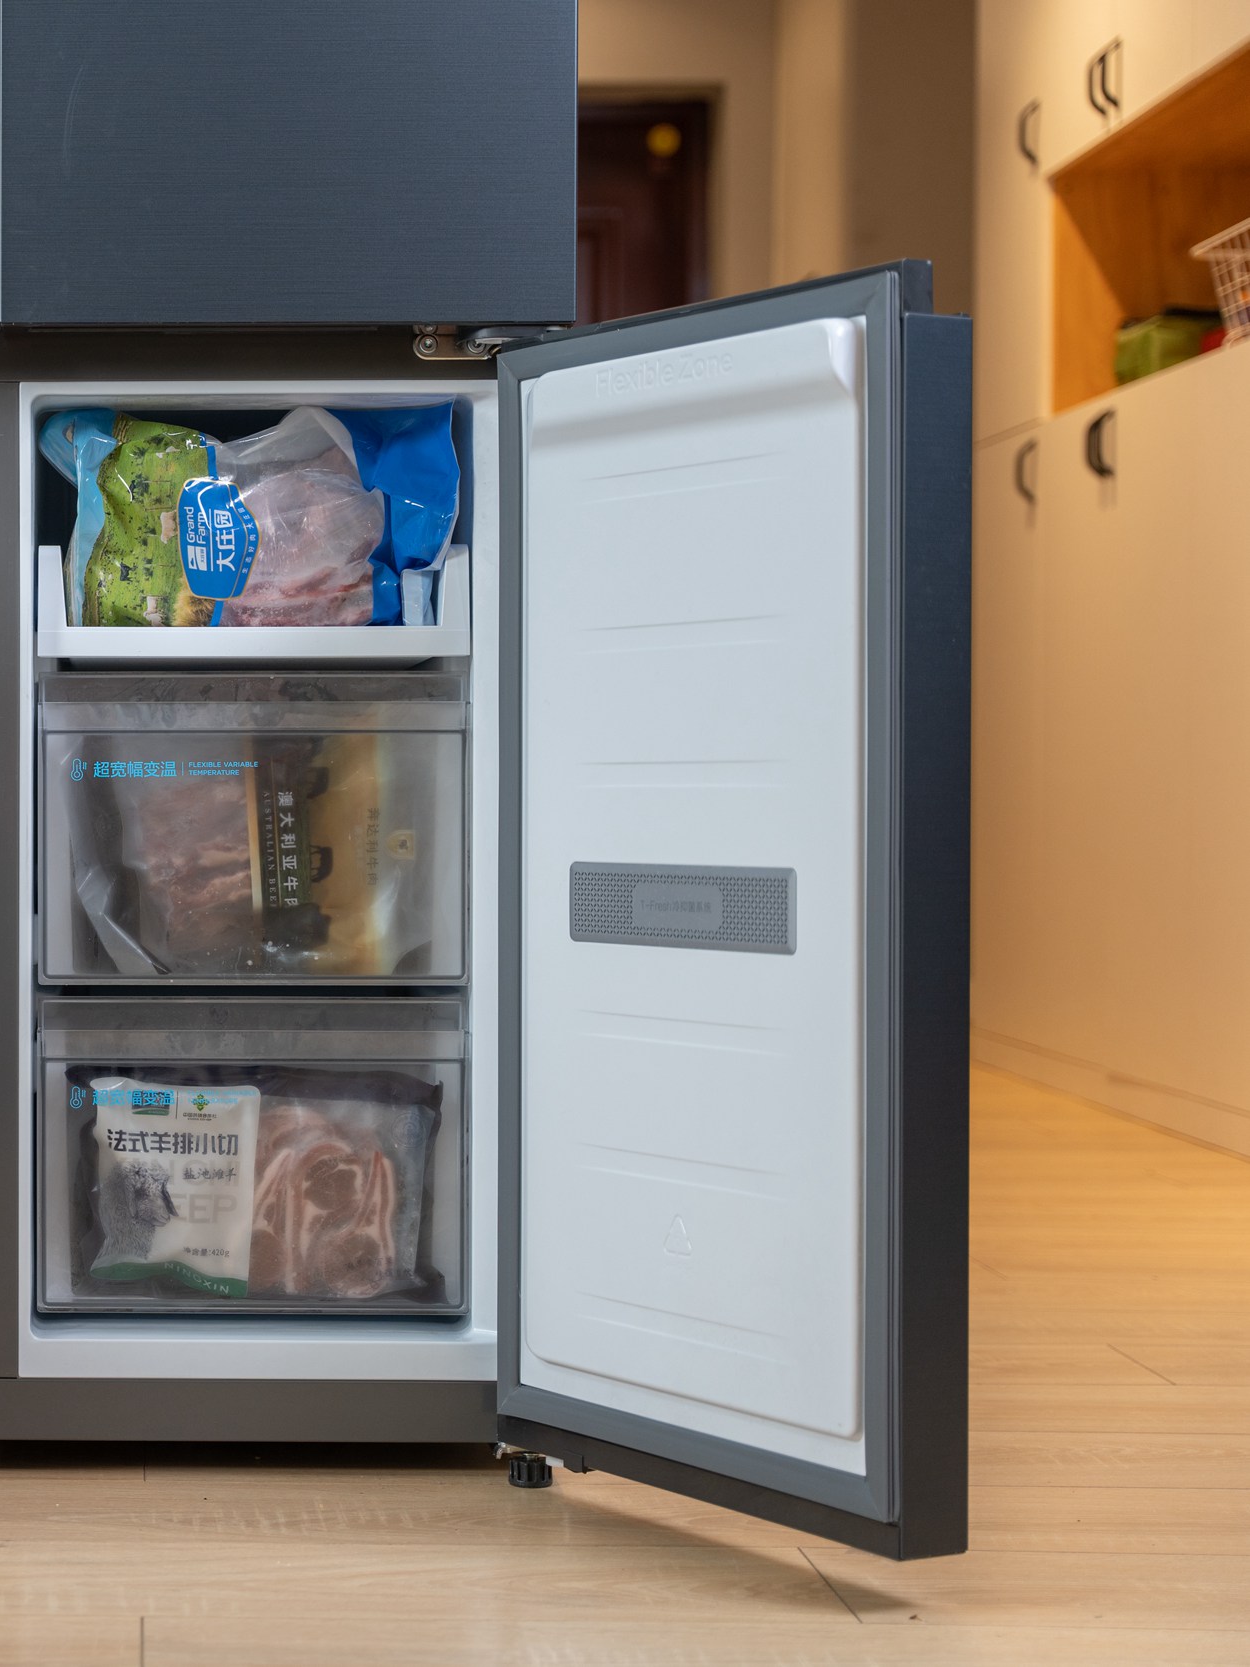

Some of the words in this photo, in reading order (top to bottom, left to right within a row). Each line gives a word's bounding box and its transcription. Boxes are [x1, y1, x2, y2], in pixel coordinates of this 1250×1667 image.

[595, 359, 674, 398] Flexible
[678, 352, 733, 383] Zone
[184, 506, 194, 543] Grand
[197, 511, 207, 545] Farm
[214, 509, 235, 572] 大庄园
[93, 760, 177, 778] 超宽幅变温
[262, 791, 276, 872] AUSTRALIAN
[92, 1089, 175, 1107] 超宽幅变温
[107, 1129, 239, 1156] 法式羊排小切
